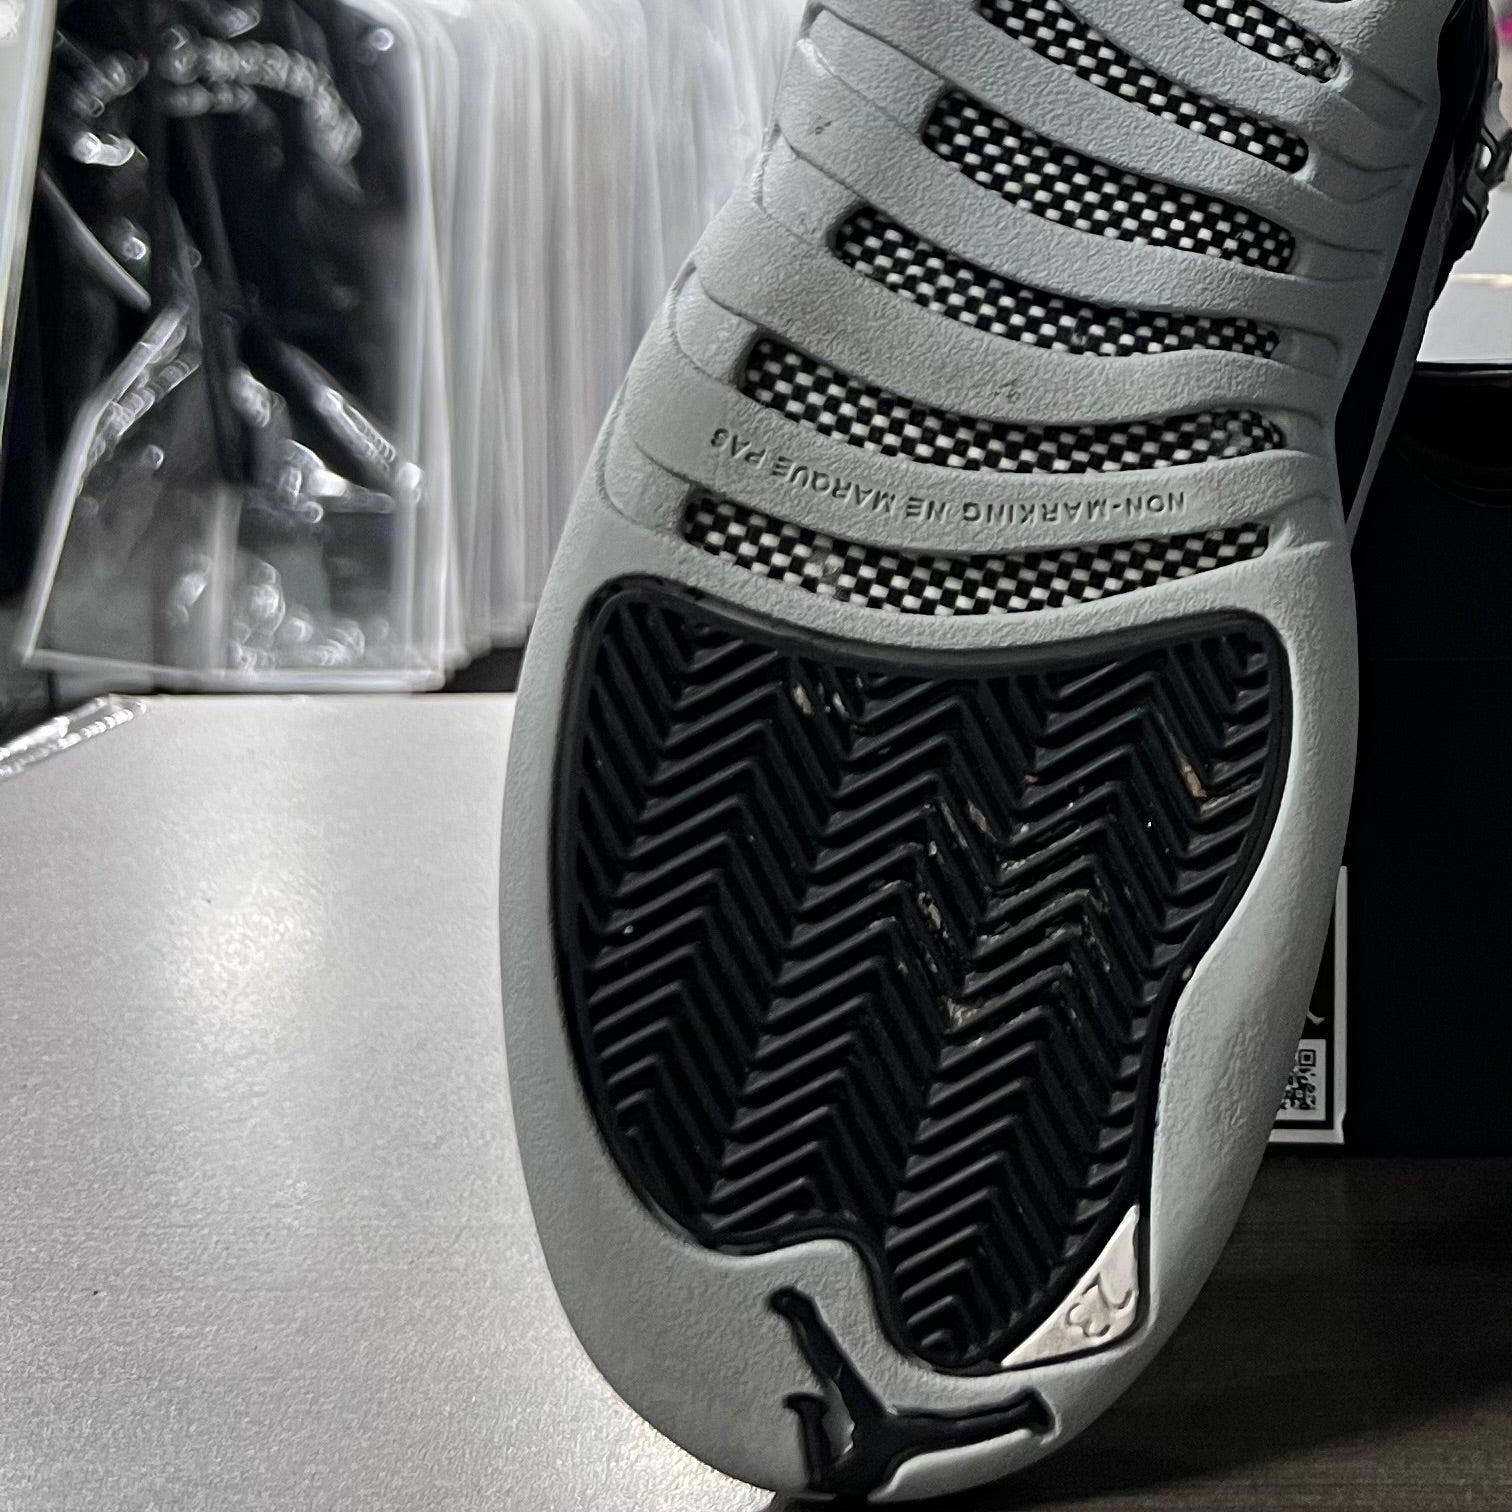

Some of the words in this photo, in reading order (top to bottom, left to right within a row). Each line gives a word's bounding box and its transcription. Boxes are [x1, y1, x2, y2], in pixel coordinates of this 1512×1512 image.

[710, 426, 767, 470] PAS
[771, 456, 898, 515] MARQUE
[904, 497, 949, 523] NE
[962, 490, 1186, 526] NON-MARKING
